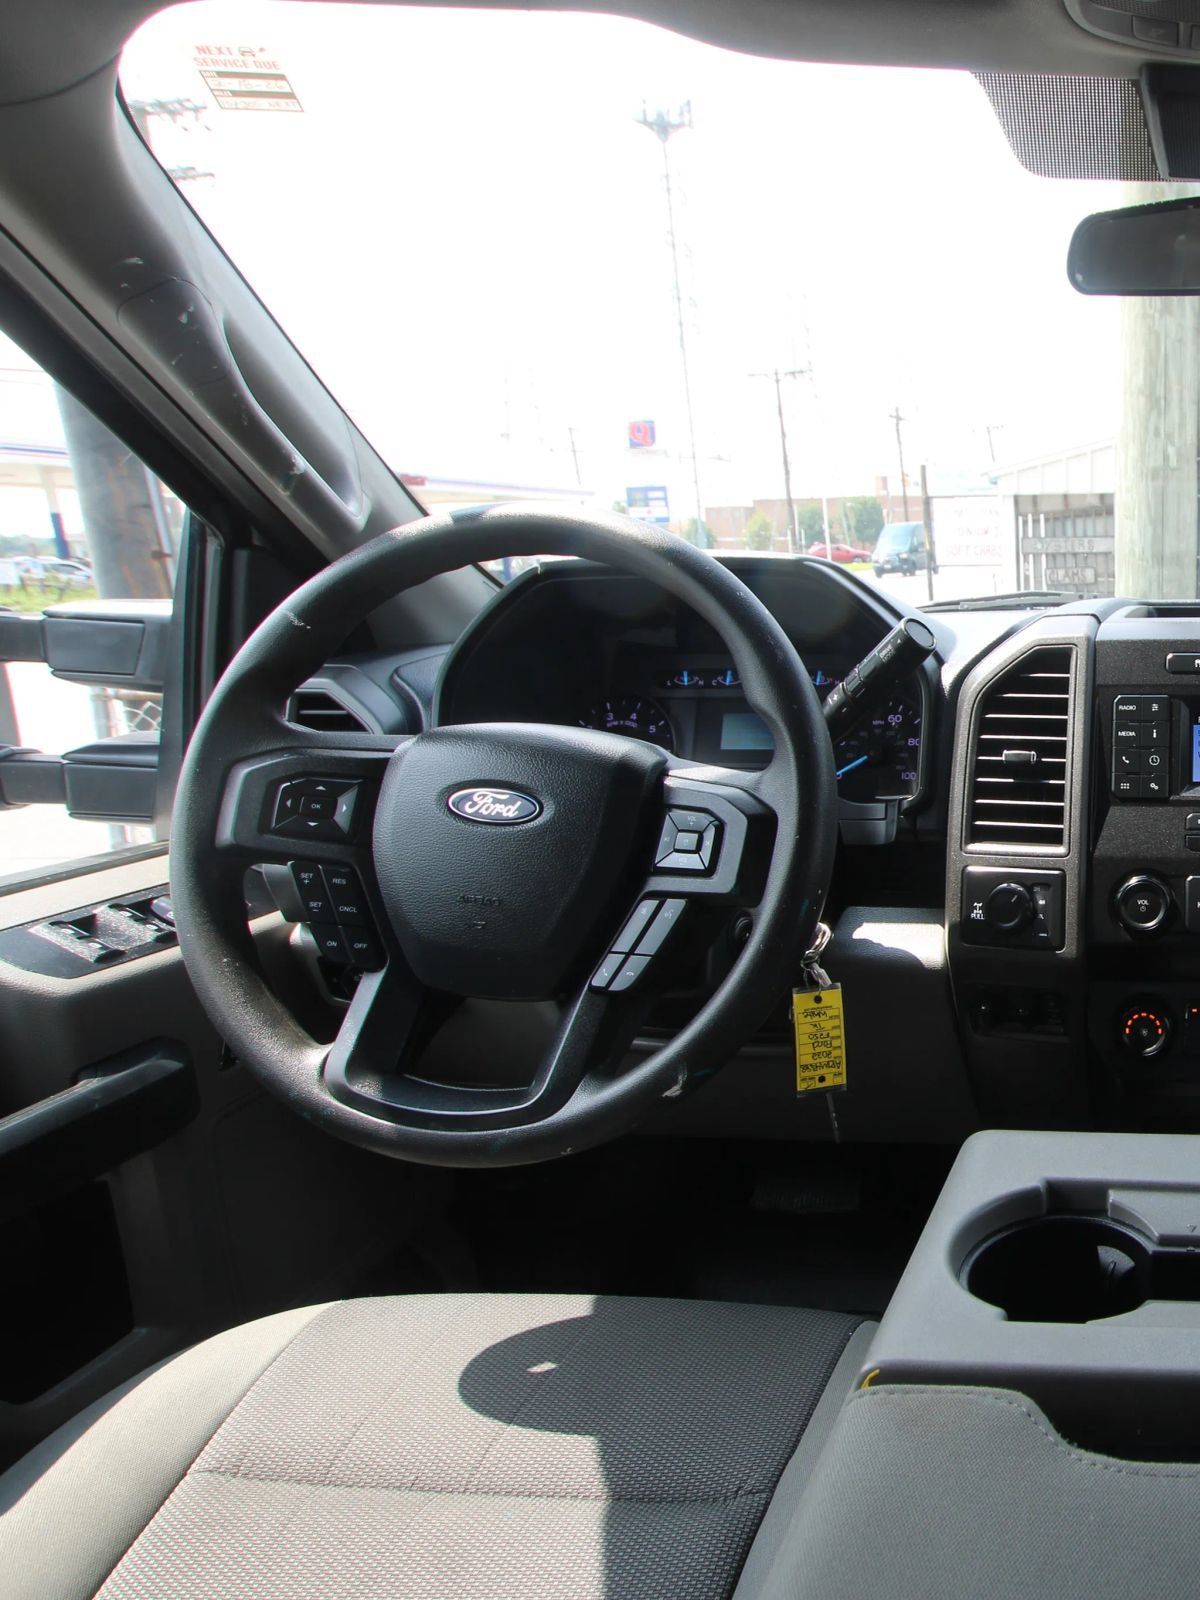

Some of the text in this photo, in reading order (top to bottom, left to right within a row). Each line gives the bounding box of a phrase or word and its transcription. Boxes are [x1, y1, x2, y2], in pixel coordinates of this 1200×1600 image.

[195, 46, 232, 56] NEXT
[193, 57, 281, 70] SERVICE DUE
[605, 712, 614, 721] 3
[629, 712, 638, 721] 4
[887, 714, 903, 723] 60
[648, 724, 657, 733] 5
[901, 771, 917, 780] 100
[464, 790, 522, 818] Ford
[338, 905, 358, 913] CNCL
[326, 940, 338, 948] ON
